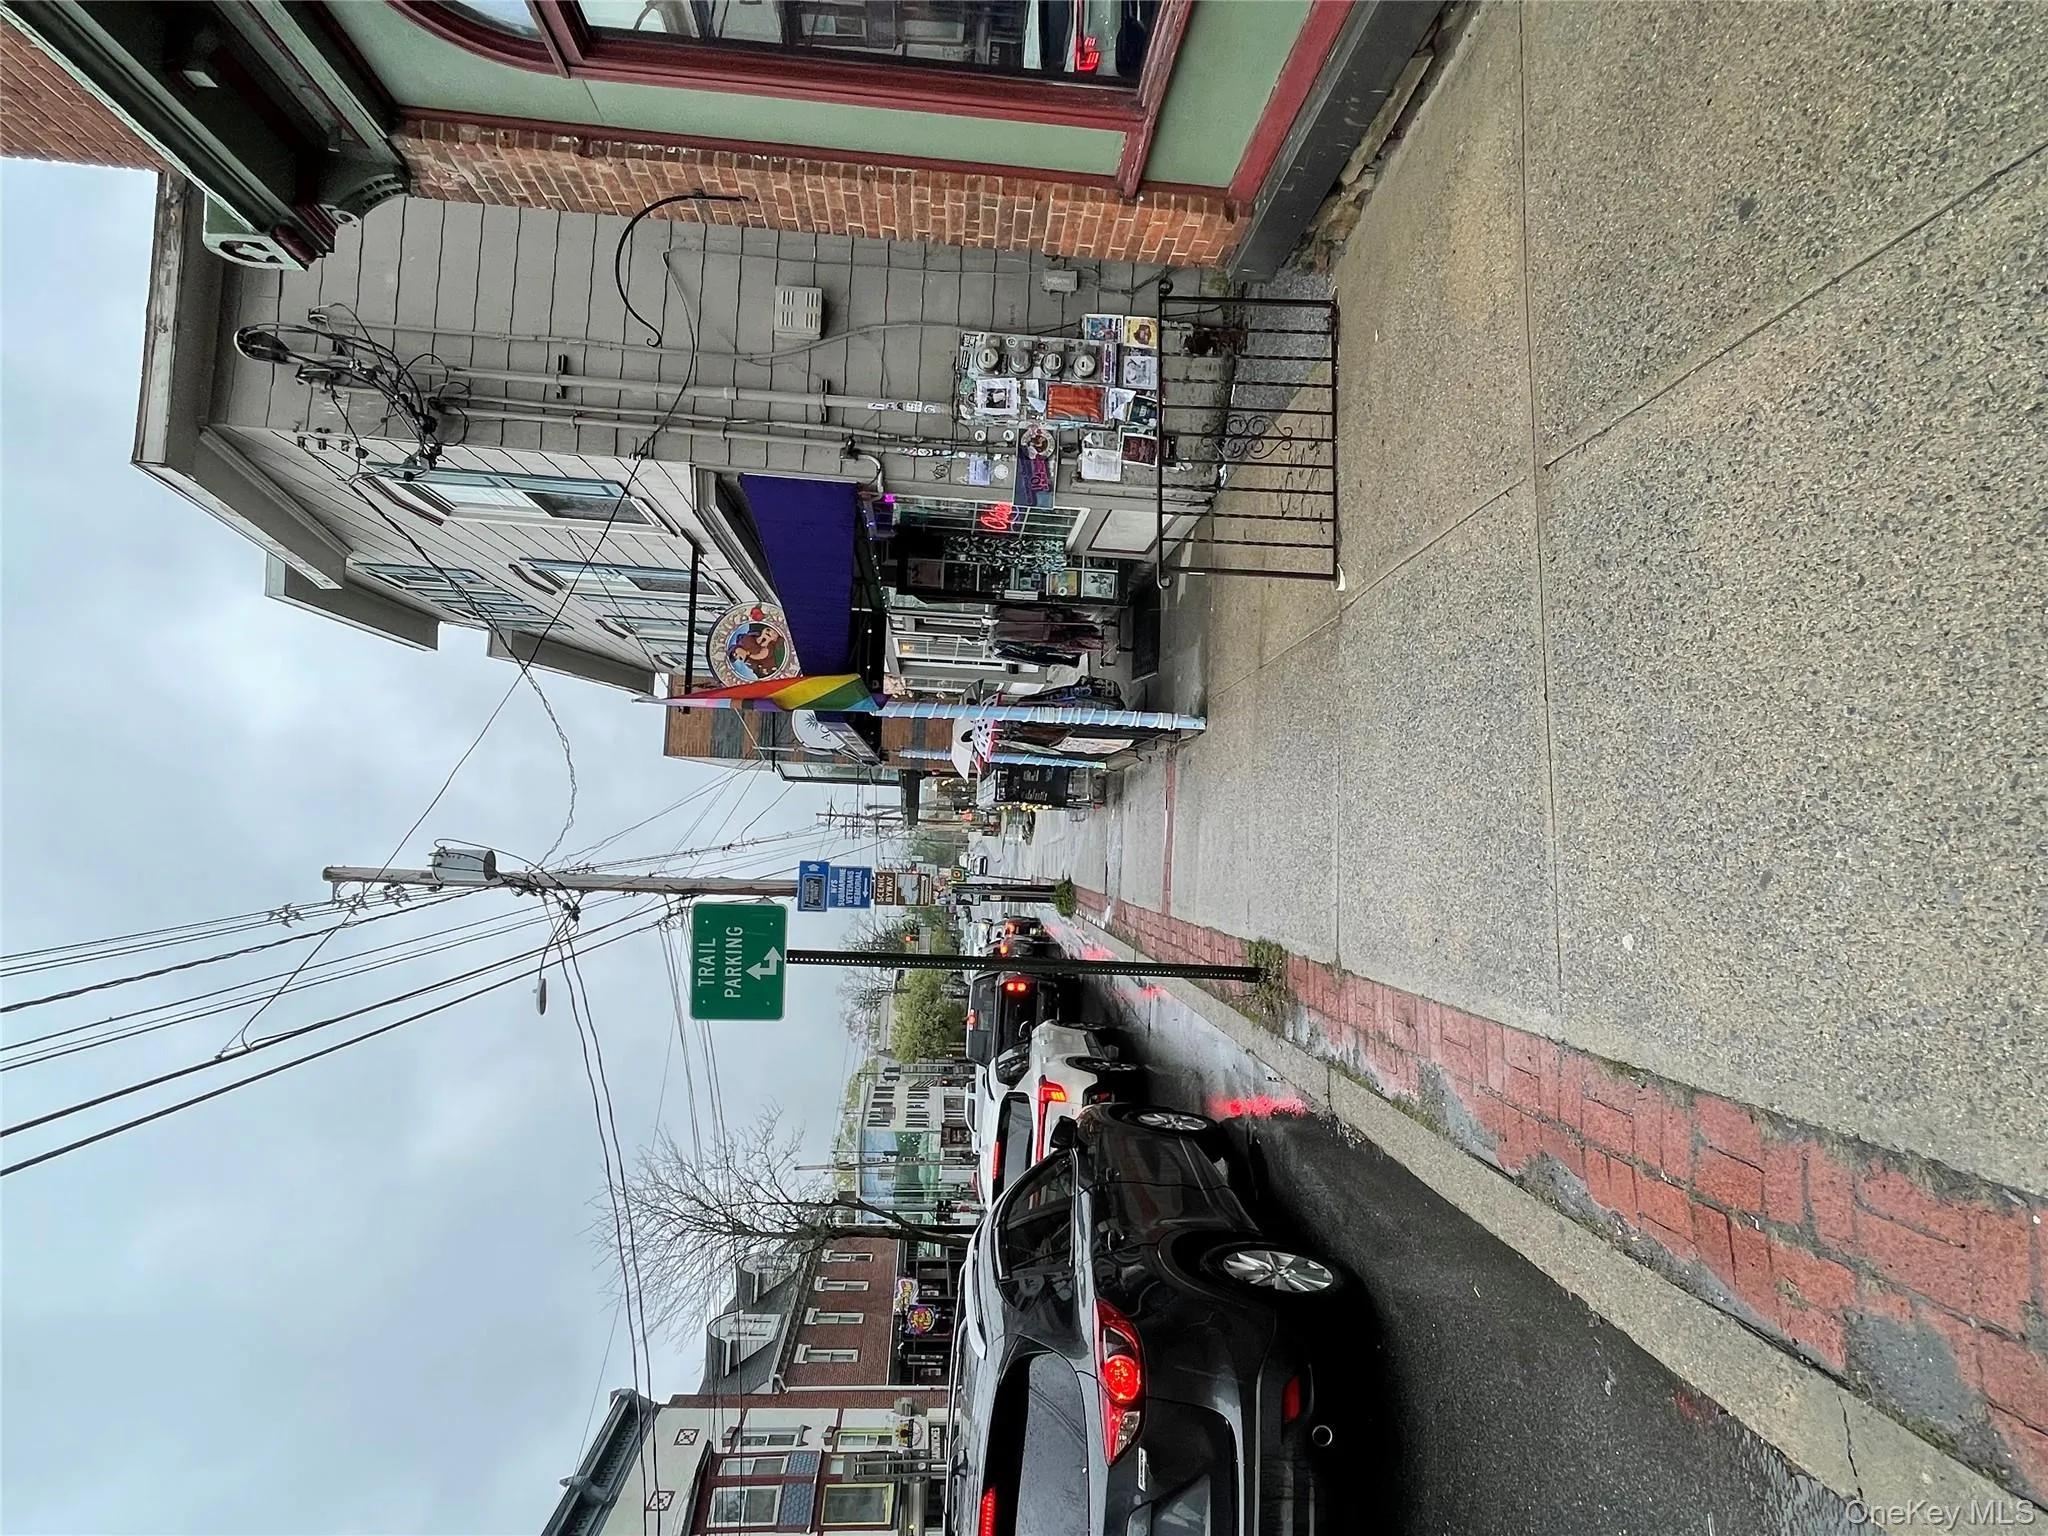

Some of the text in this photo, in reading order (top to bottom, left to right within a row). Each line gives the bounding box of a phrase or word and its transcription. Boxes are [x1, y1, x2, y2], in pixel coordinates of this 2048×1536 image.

[830, 880, 838, 894] NYS
[838, 868, 846, 906] SUBMARINE
[846, 870, 854, 904] VETERANS
[854, 870, 862, 905] MEMORIAL
[877, 875, 885, 902] SCENIC
[885, 876, 893, 902] BYWAY
[698, 938, 716, 987] TRAIL
[724, 926, 743, 998] PARKING
